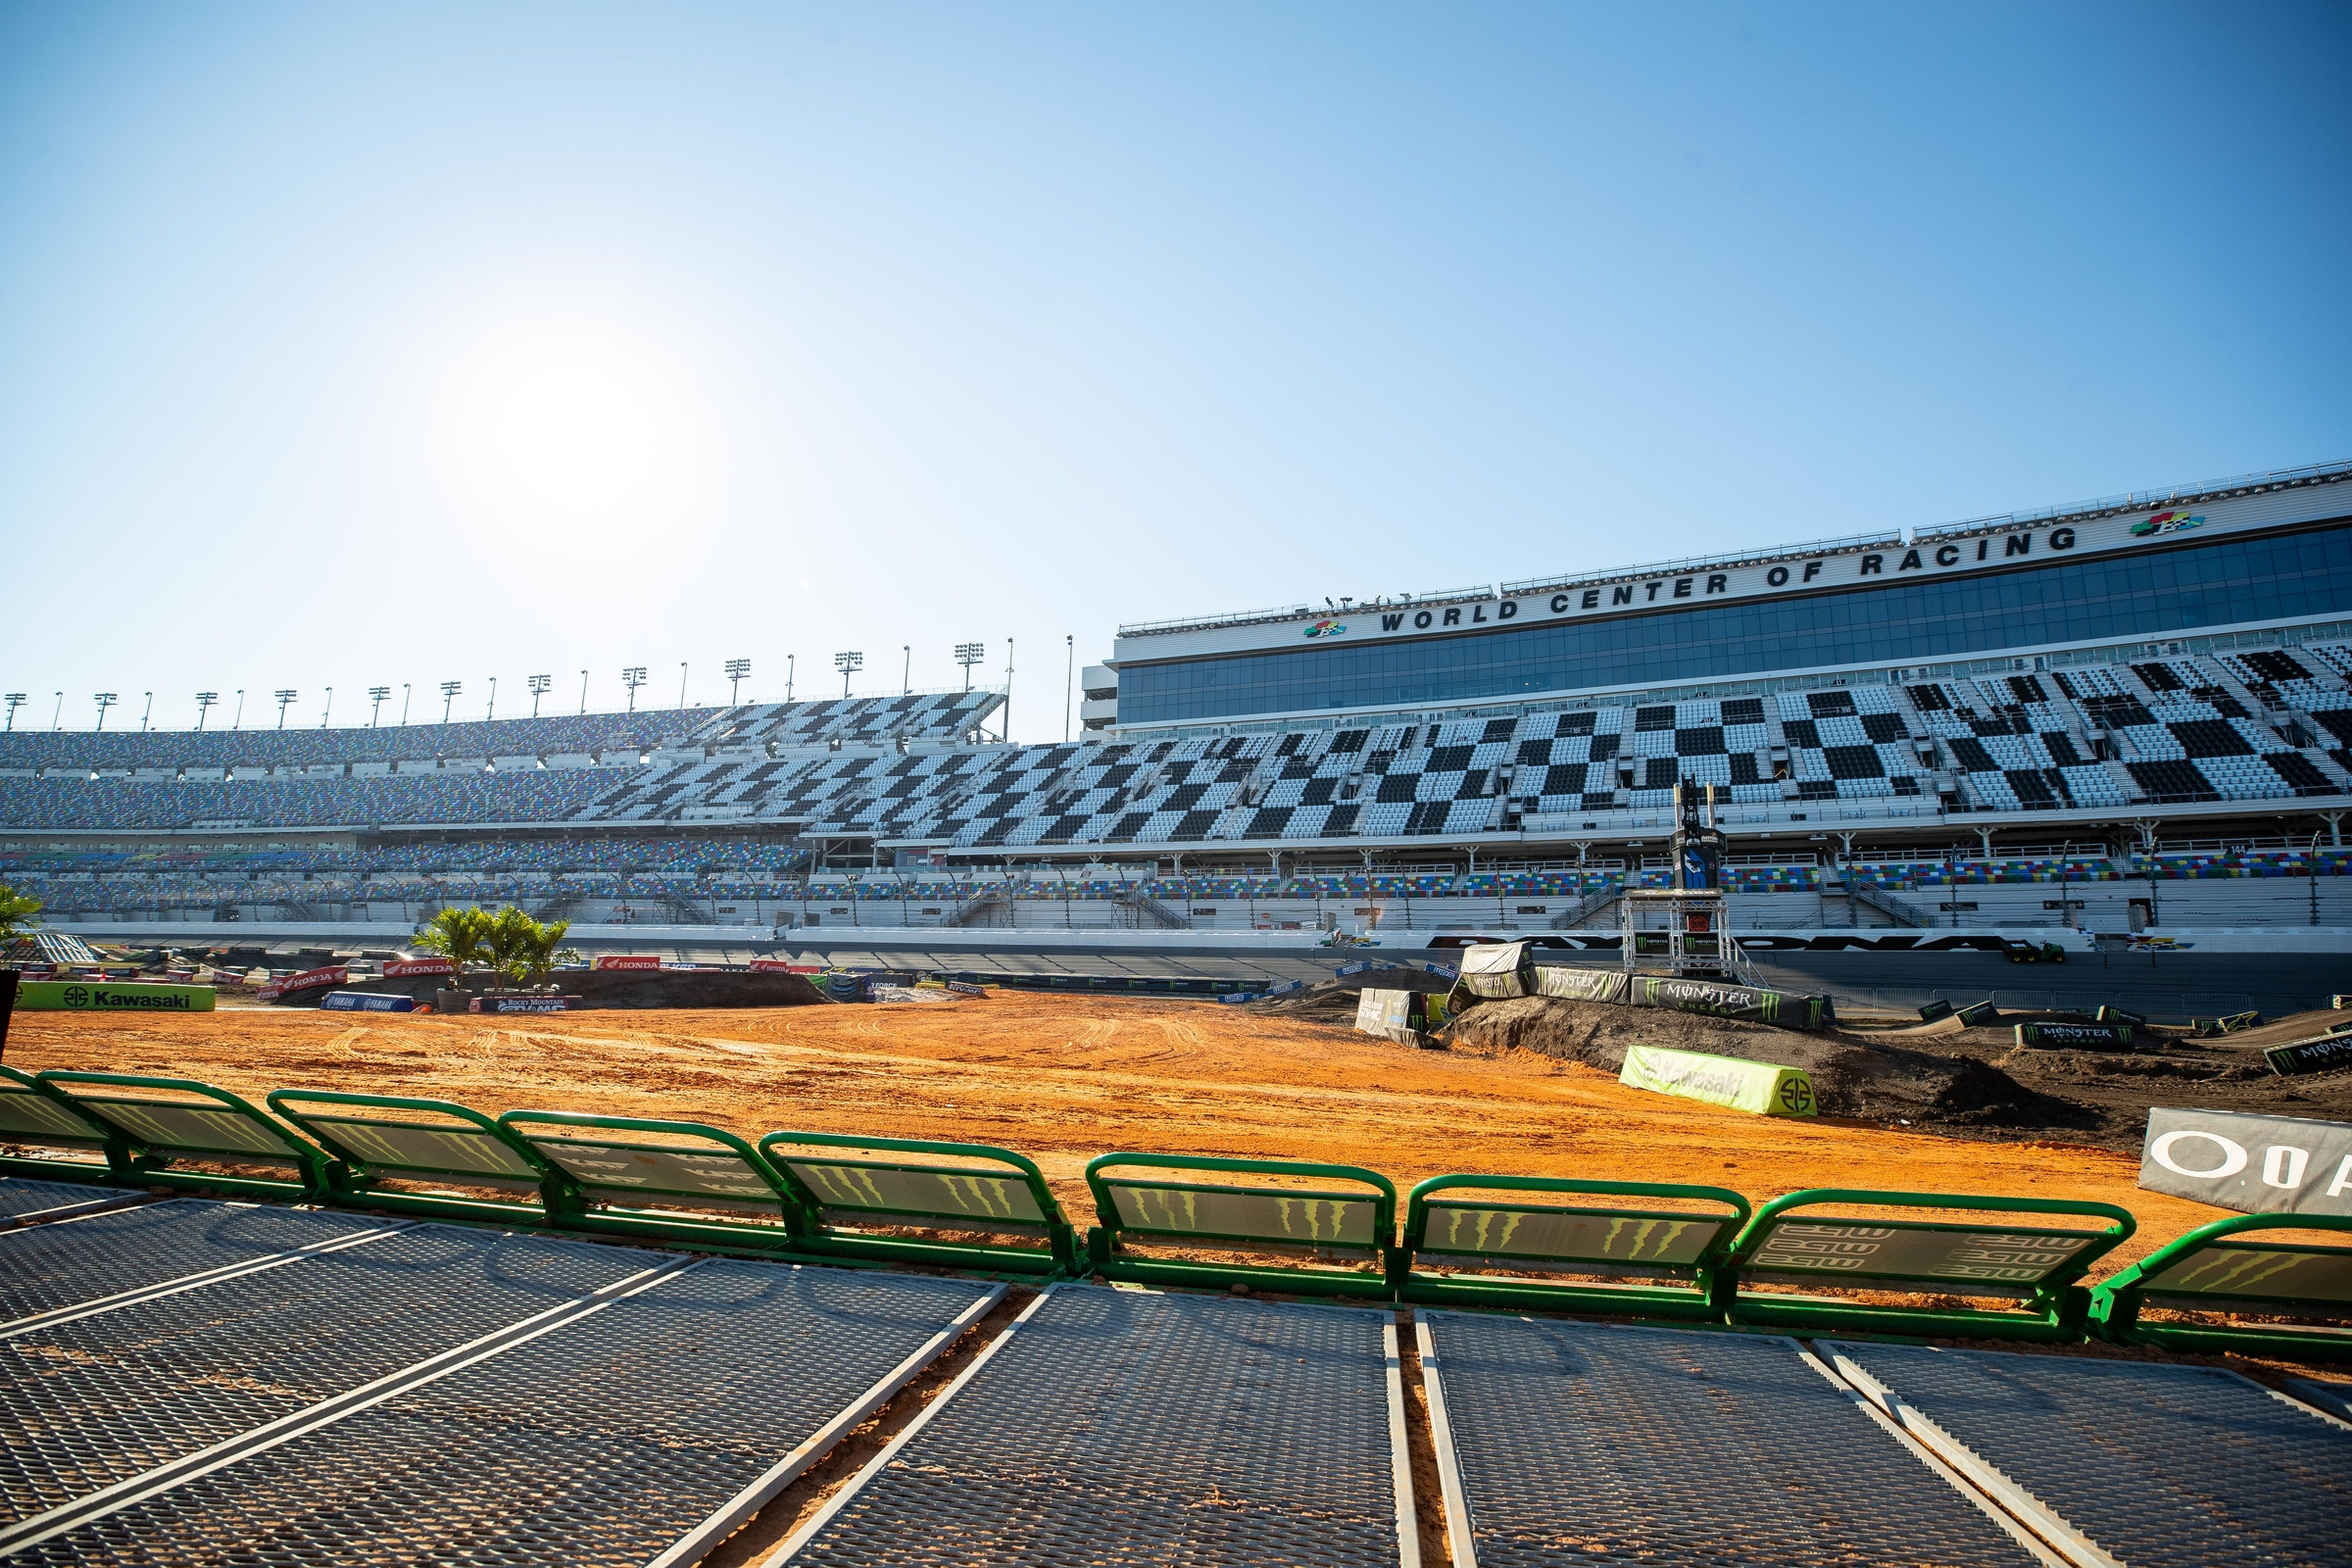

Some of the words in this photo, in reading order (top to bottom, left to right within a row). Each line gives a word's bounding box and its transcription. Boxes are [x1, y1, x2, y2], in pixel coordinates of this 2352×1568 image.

[1381, 601, 1518, 632] WORLD
[1550, 574, 1729, 614] CENTER
[1766, 561, 1824, 588] OF
[1859, 527, 2076, 576] RACING
[2230, 845, 2245, 855] 144
[400, 964, 454, 974] HONDA
[1548, 972, 1596, 990] MONSTER
[94, 991, 190, 1008] Kawasaki
[1667, 983, 1754, 1007] MONSTER
[333, 997, 355, 1007] YAMAHA
[370, 999, 393, 1009] YAMAHA
[1678, 1002, 1738, 1013] ENERGY
[2043, 1027, 2113, 1039] MONSTER
[1659, 1060, 1745, 1098] Kawasaki
